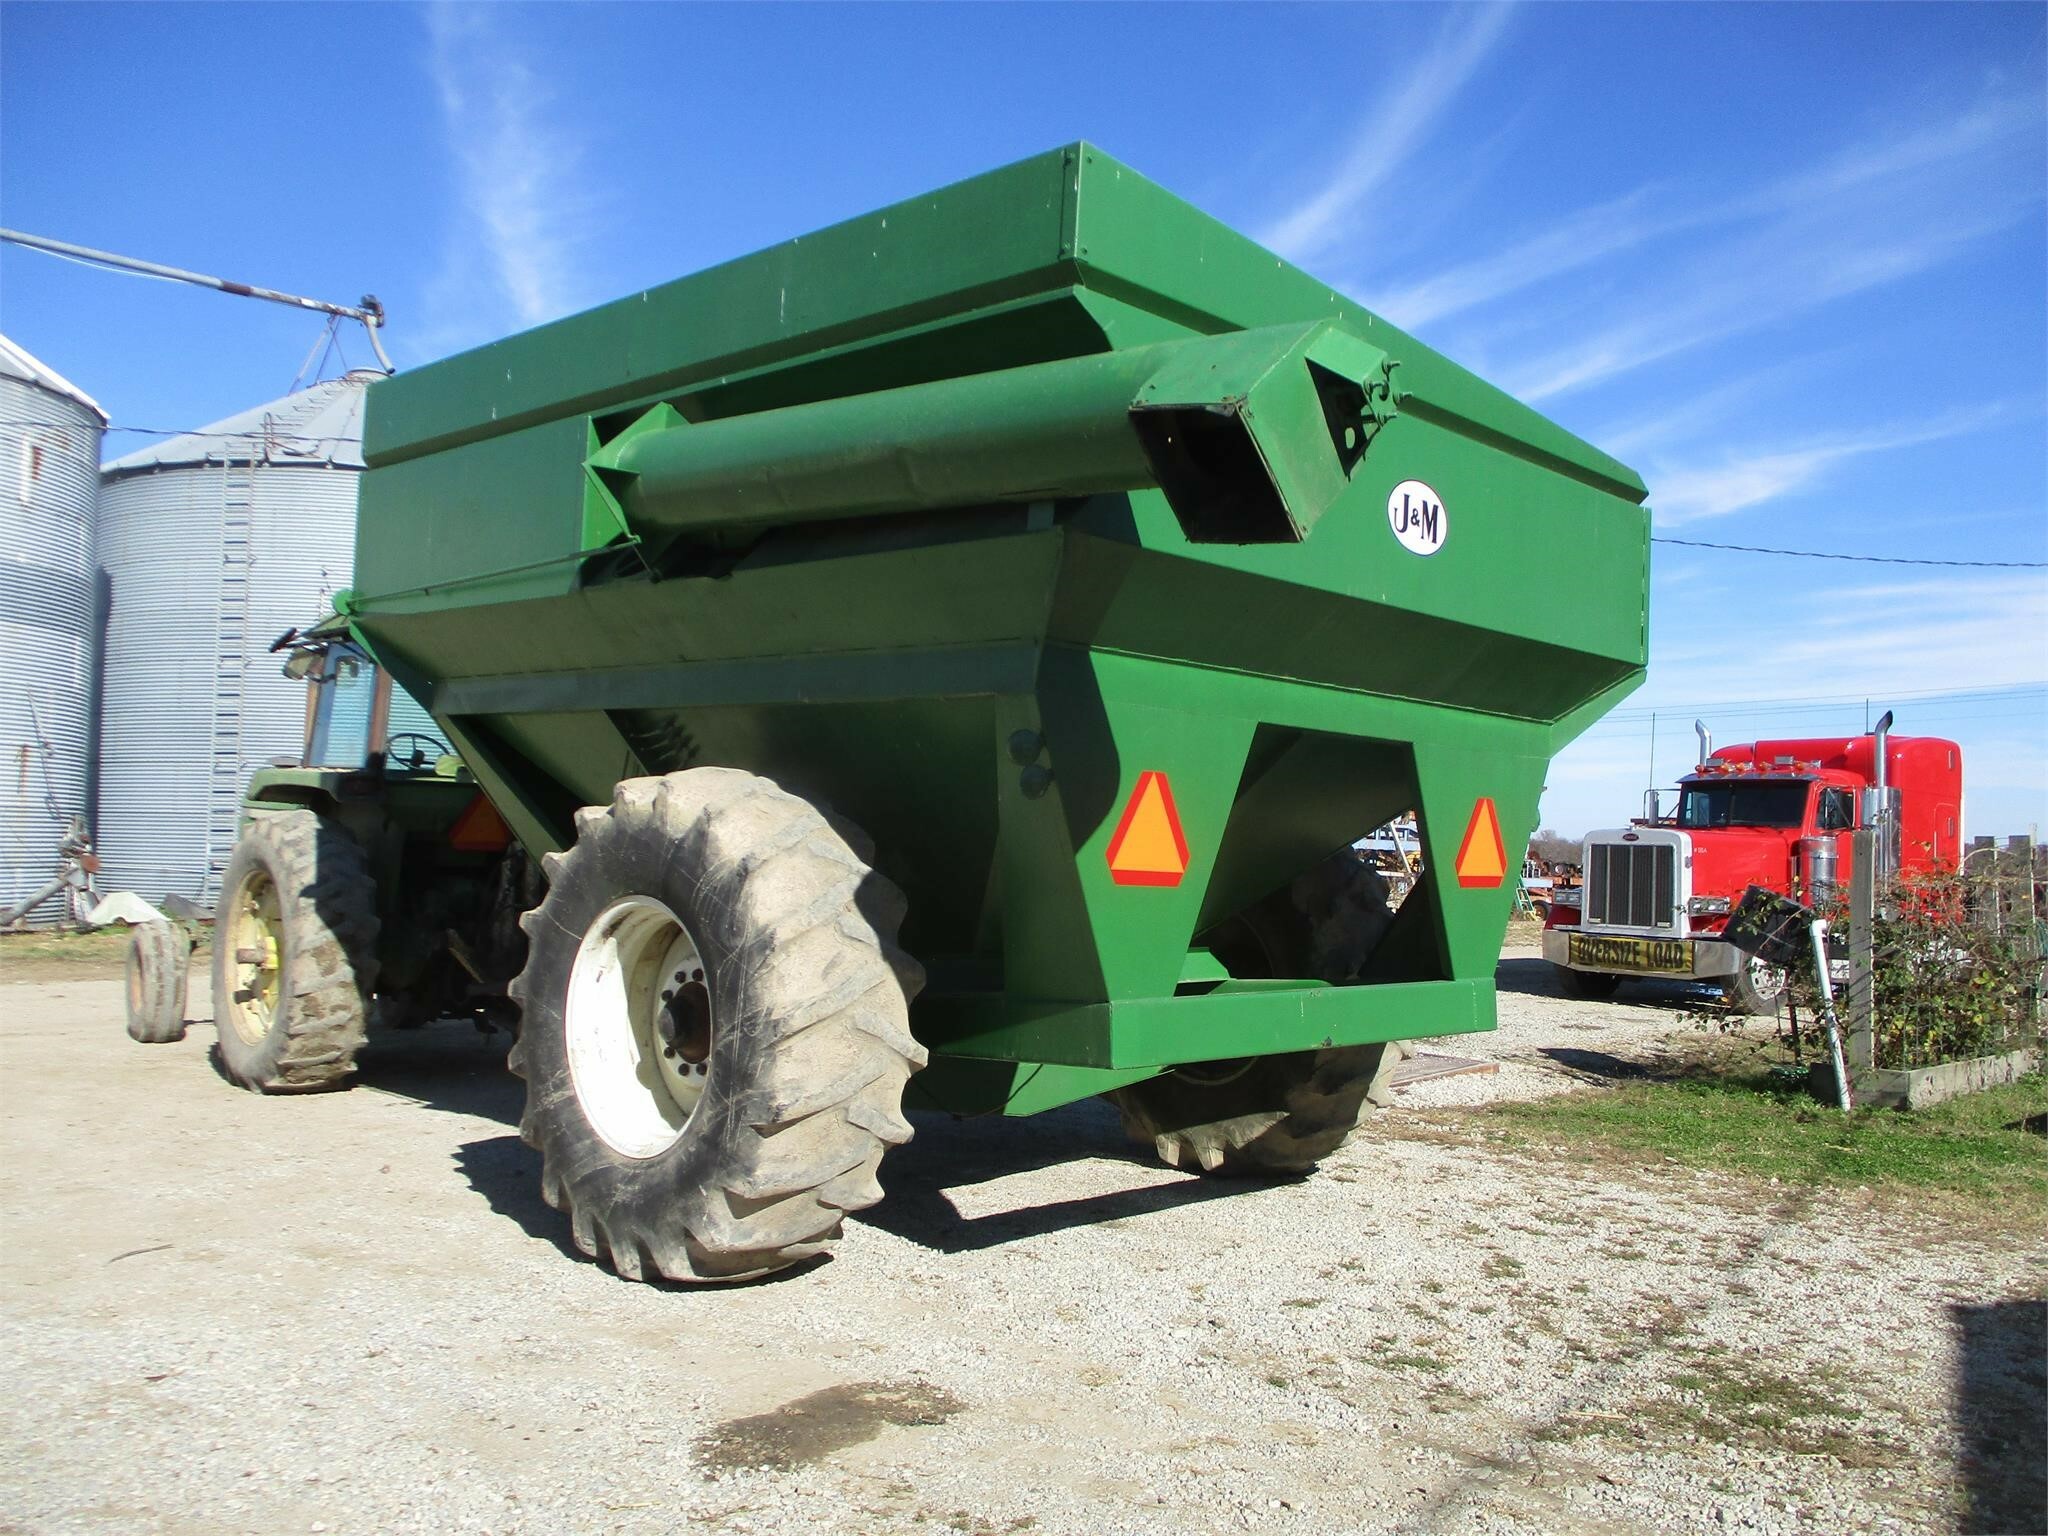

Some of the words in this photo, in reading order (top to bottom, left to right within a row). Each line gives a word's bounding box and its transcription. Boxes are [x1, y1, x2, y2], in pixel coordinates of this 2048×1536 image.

[1394, 493, 1439, 544] J&M
[1578, 936, 1641, 967] OVERSIZE
[1647, 941, 1684, 969] LOAD
